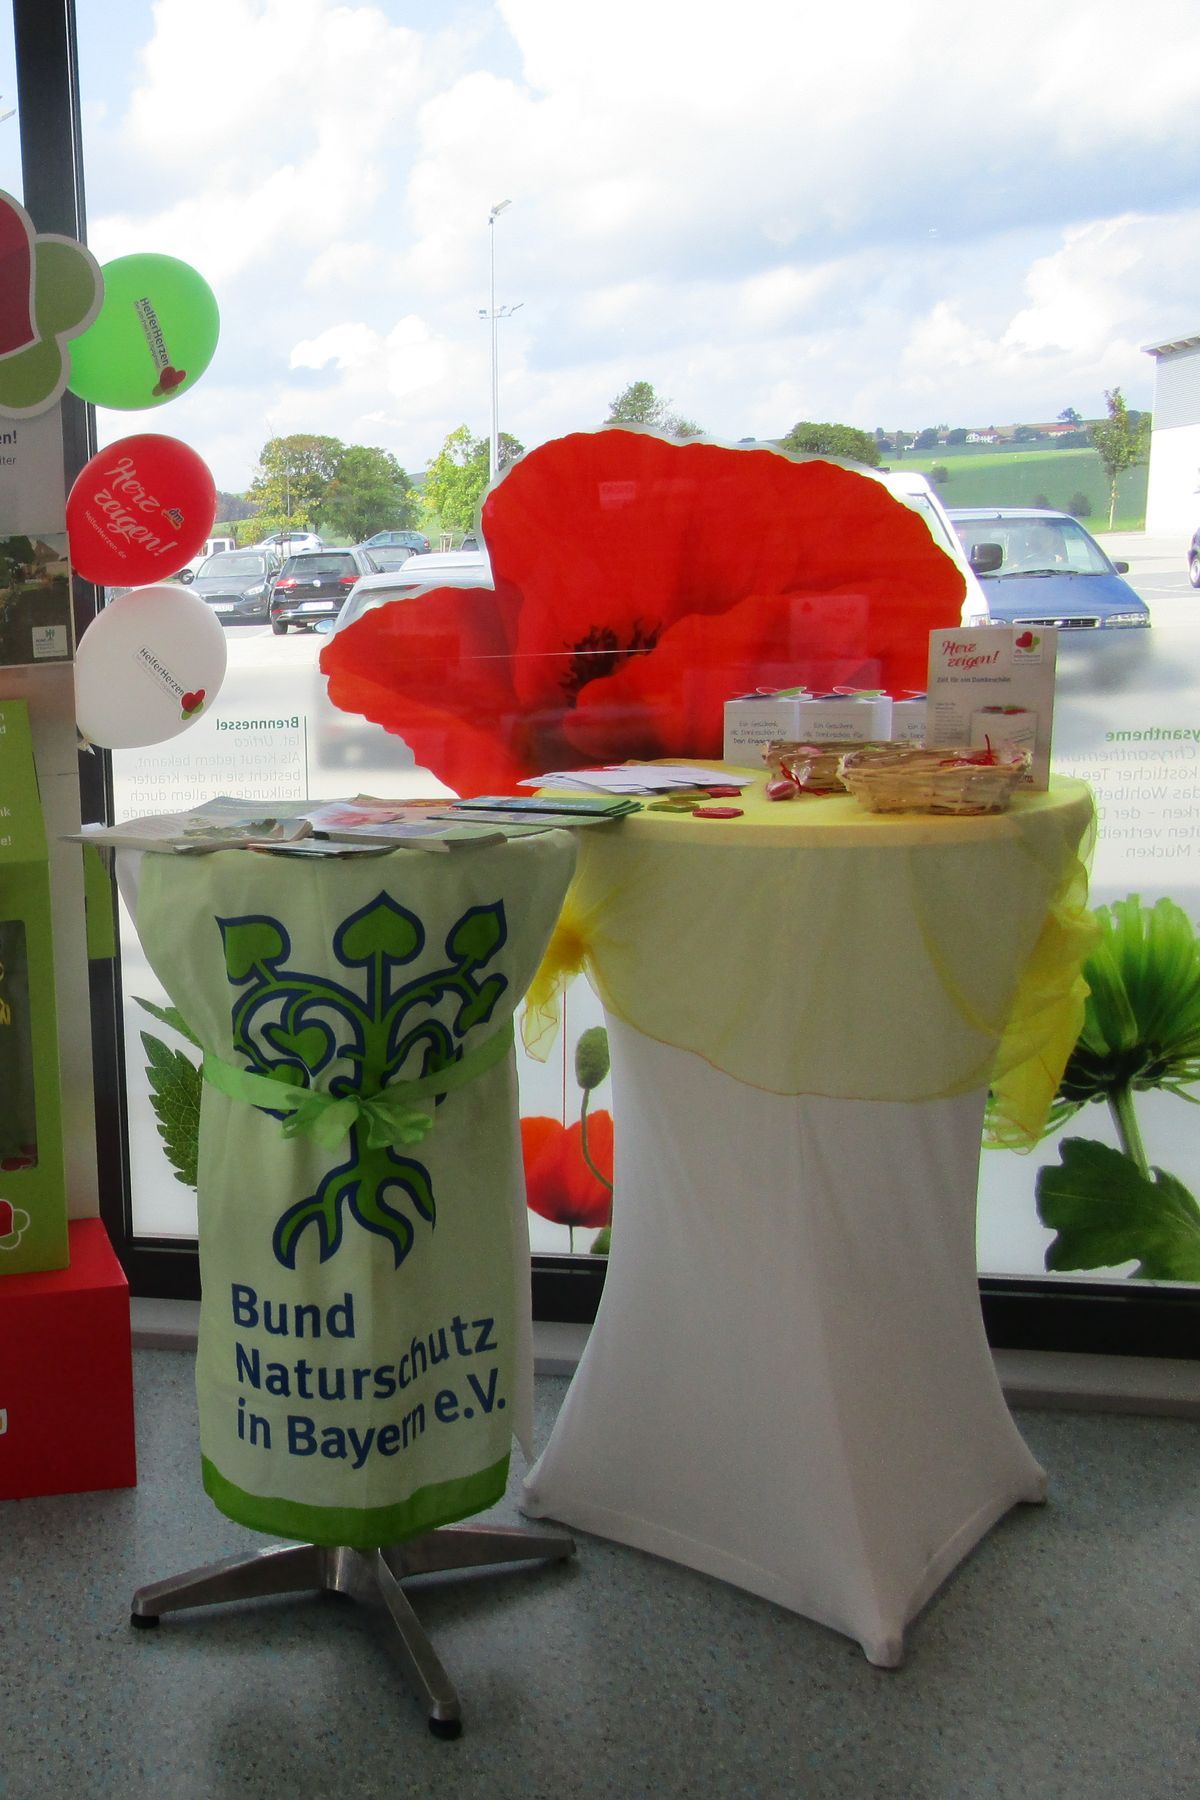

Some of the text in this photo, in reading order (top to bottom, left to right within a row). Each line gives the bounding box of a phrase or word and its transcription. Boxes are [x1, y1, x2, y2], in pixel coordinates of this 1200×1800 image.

[139, 296, 169, 366] HelferHerzen
[103, 457, 160, 513] Herz
[93, 488, 178, 556] zeigen!
[169, 508, 184, 524] dm
[139, 647, 185, 696] HelferHerzen
[942, 640, 977, 656] Herz
[947, 650, 1000, 671] zeigen!
[231, 1283, 356, 1339] Bund
[235, 1315, 499, 1401] Naturschutz
[237, 1367, 507, 1470] in Bayern e.V.
